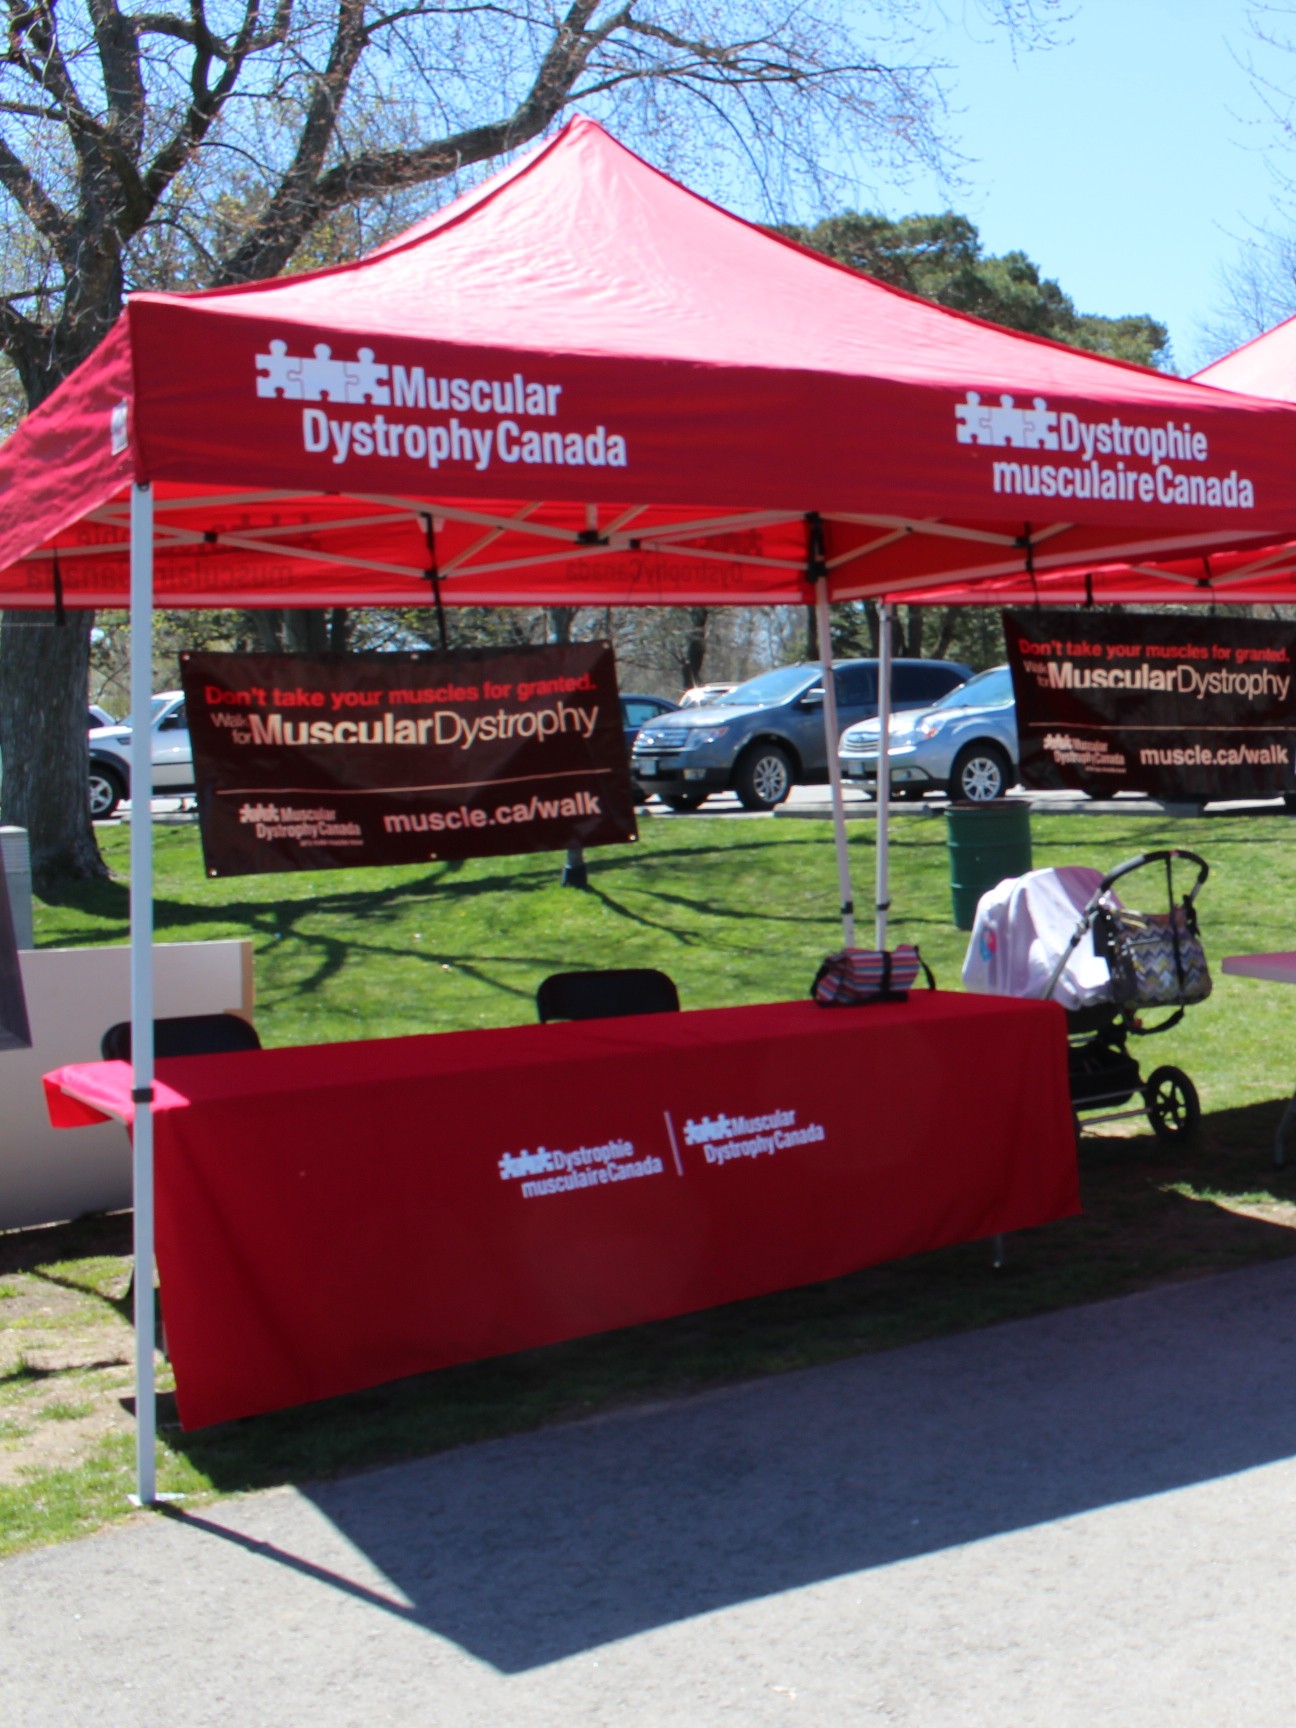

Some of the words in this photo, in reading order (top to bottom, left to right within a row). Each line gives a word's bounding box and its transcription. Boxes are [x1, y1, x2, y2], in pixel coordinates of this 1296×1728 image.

[391, 365, 562, 417] Muscular
[1059, 412, 1208, 465] Dystrophie
[1019, 639, 1062, 656] Don't
[1065, 640, 1102, 656] take
[1106, 643, 1142, 660] your
[1145, 643, 1208, 659] muscles
[1212, 644, 1232, 659] for
[1235, 646, 1290, 664] granted.
[205, 685, 266, 706] Don't
[272, 687, 325, 707] take
[331, 690, 382, 711] your
[388, 684, 480, 705] muscles
[483, 681, 512, 699] for
[517, 673, 597, 701] granted.
[1140, 744, 1289, 767] muscle.ca/walk
[383, 792, 601, 834] muscle.ca/walk
[731, 1109, 797, 1136] Muscular
[553, 1138, 634, 1172] Dystrophie
